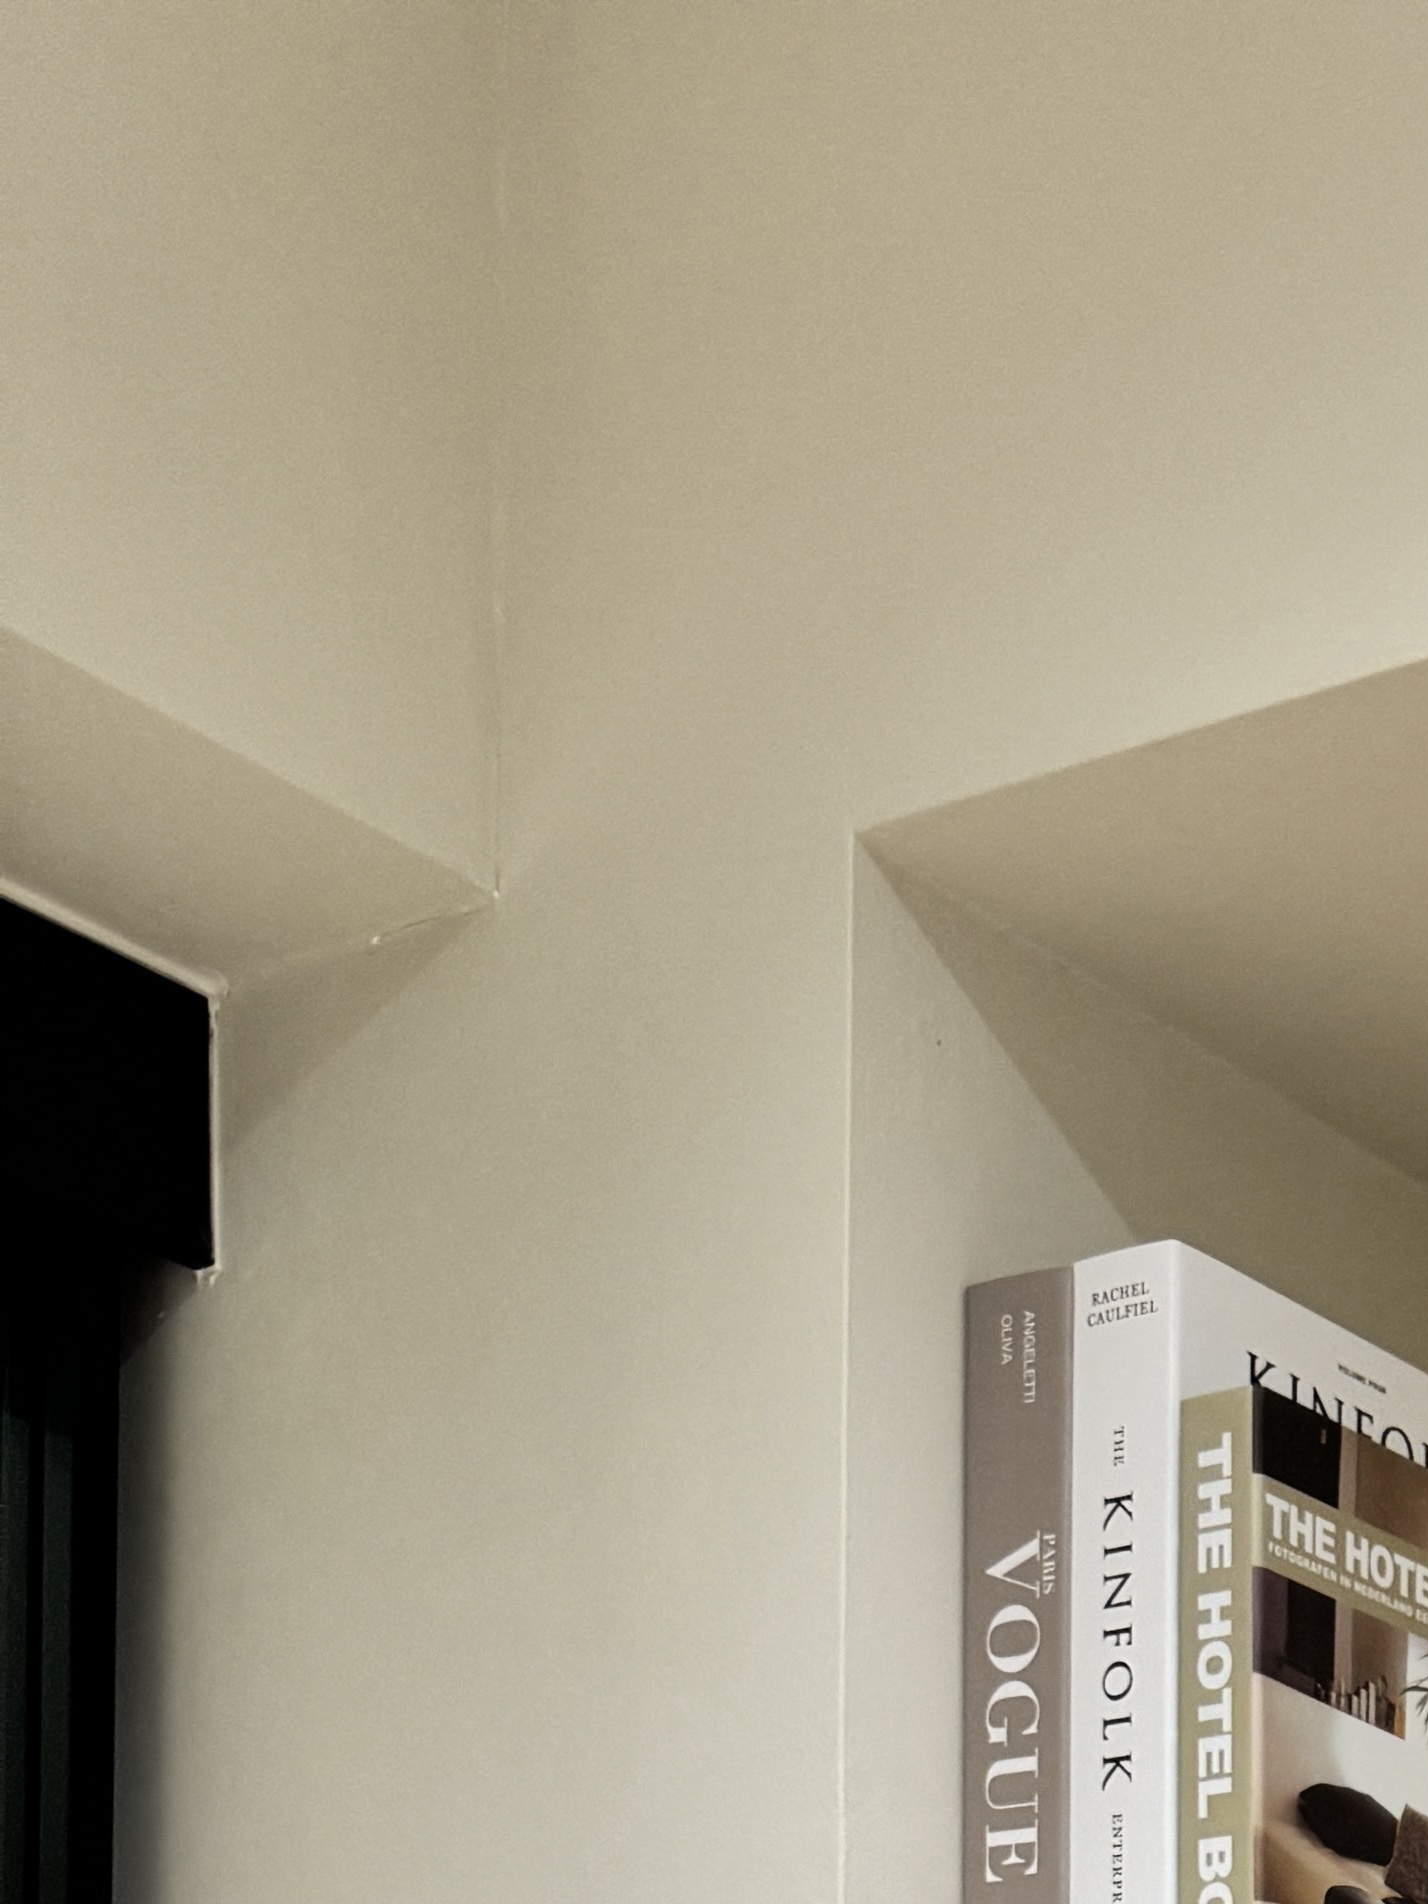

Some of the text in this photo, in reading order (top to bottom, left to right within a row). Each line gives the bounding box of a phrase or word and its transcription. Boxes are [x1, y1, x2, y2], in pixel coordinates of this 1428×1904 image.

[1087, 1300, 1158, 1327] CAULFIEL
[1092, 1281, 1149, 1306] RACHEL
[1001, 1314, 1013, 1365] OLIVA
[1022, 1310, 1036, 1404] ANGELETTI
[1113, 1426, 1125, 1467] THE
[1197, 1432, 1232, 1573] THE
[1265, 1492, 1336, 1565] THE
[1041, 1533, 1056, 1595] PARIS
[1101, 1490, 1133, 1792] KINFOLK
[985, 1530, 1040, 1882] VOGUE
[1197, 1590, 1233, 1819] HOTEL
